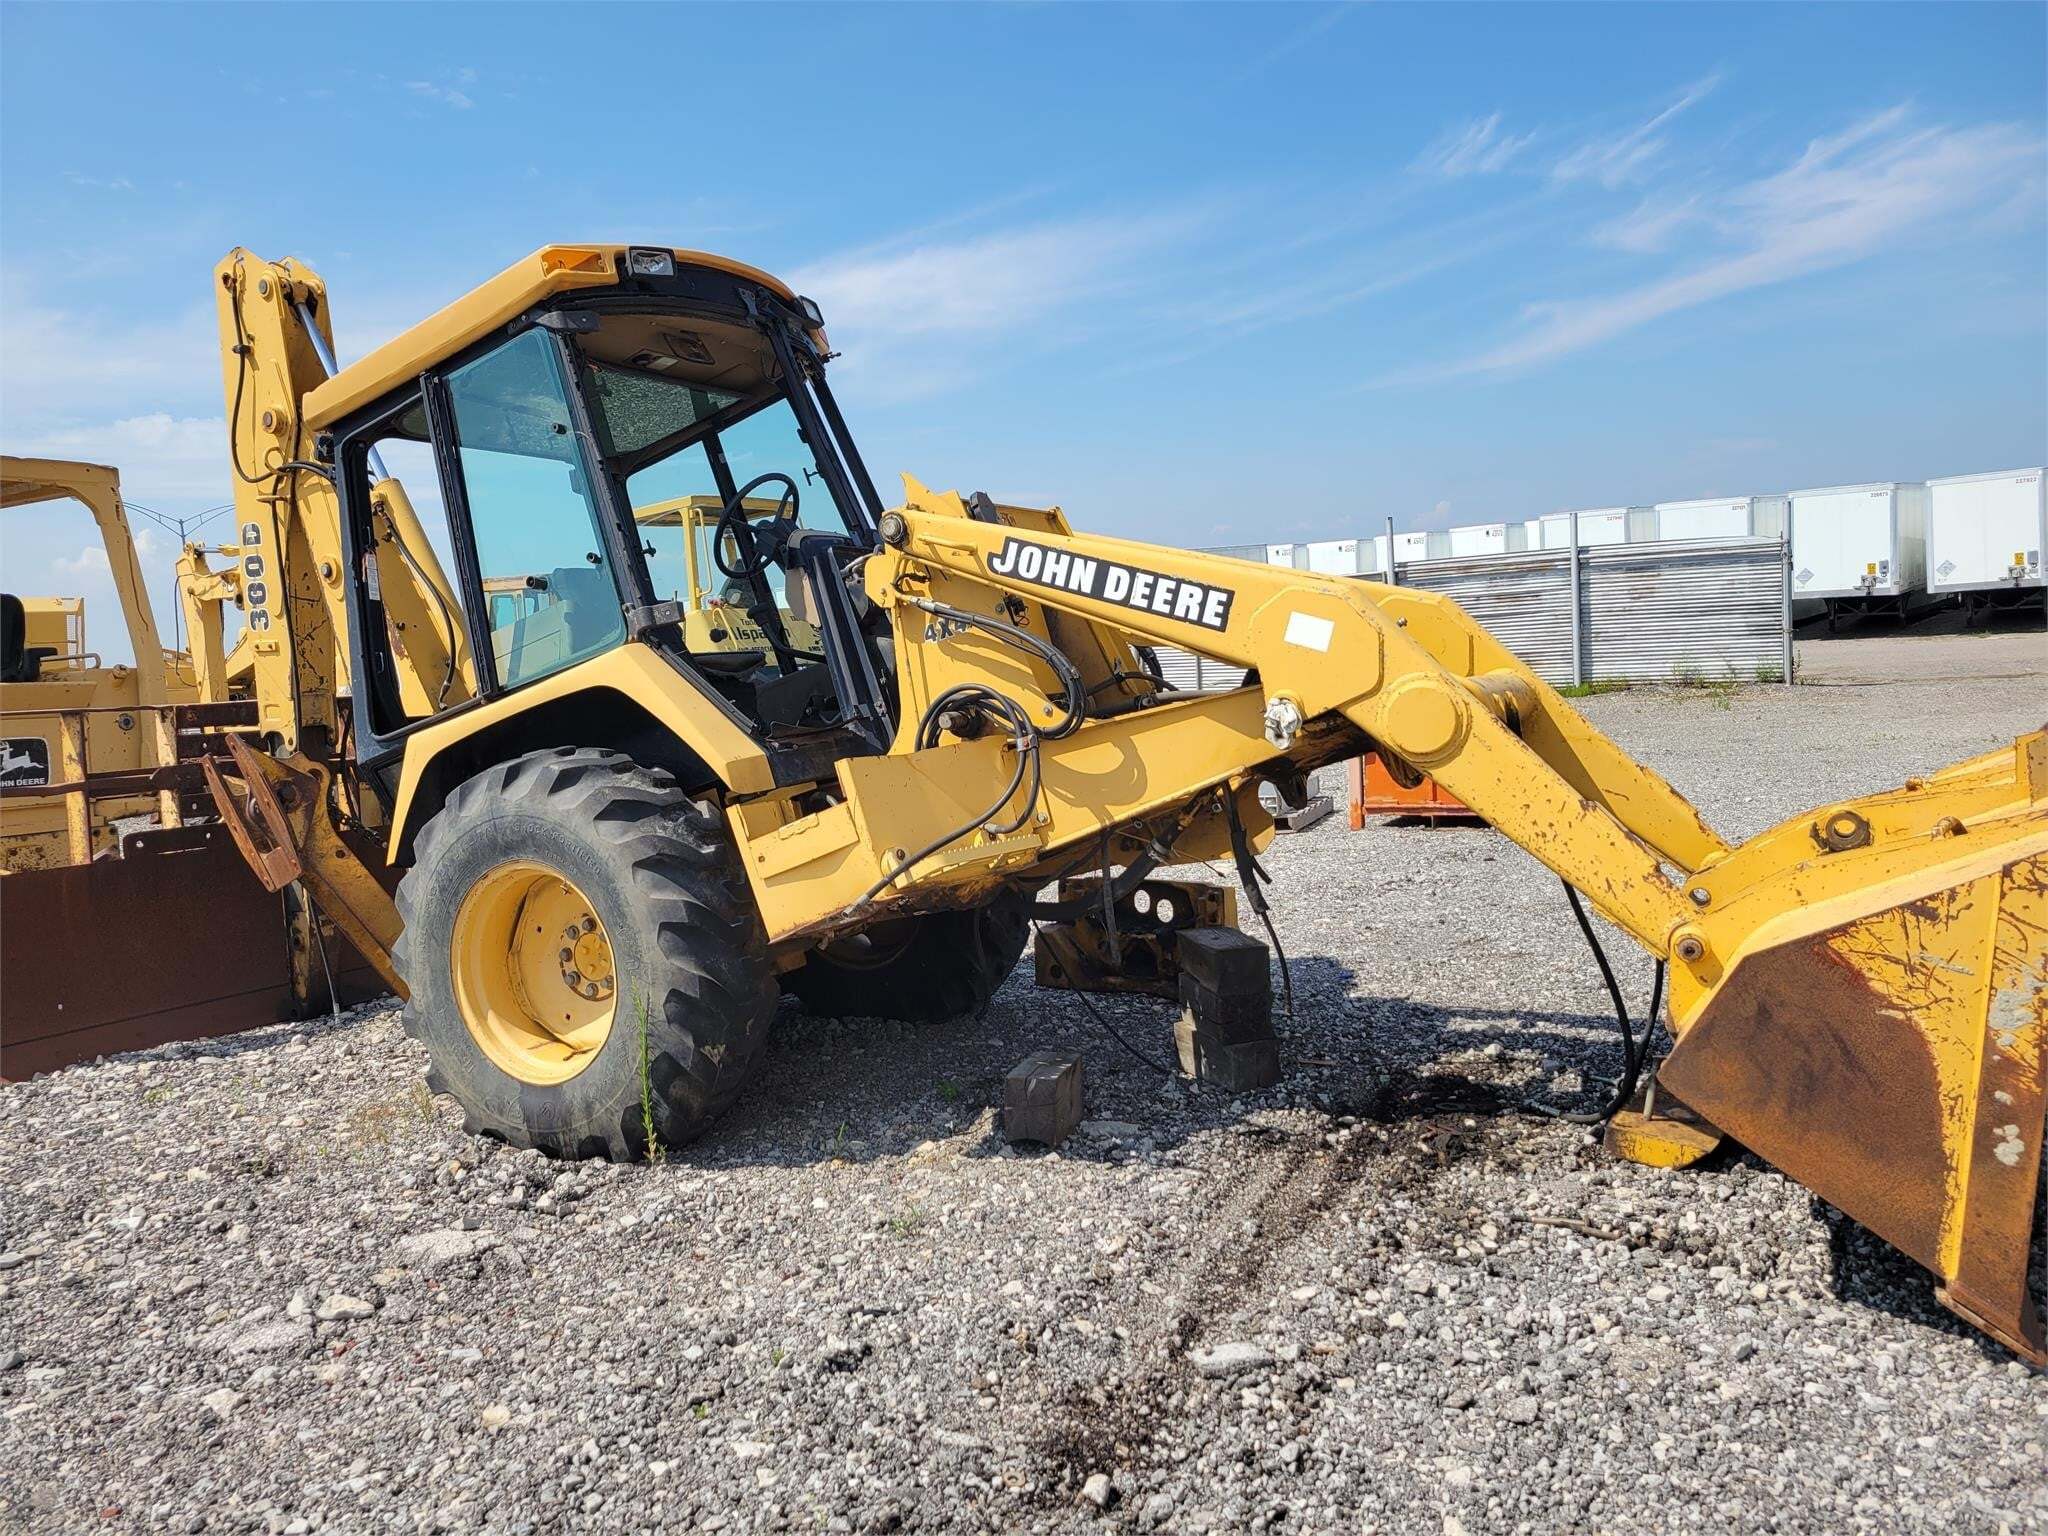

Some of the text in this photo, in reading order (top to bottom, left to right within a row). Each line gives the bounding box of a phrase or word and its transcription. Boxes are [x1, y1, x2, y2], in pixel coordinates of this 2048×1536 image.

[992, 541, 1228, 627] JOHN DEERE
[16, 777, 46, 786] DEERE
